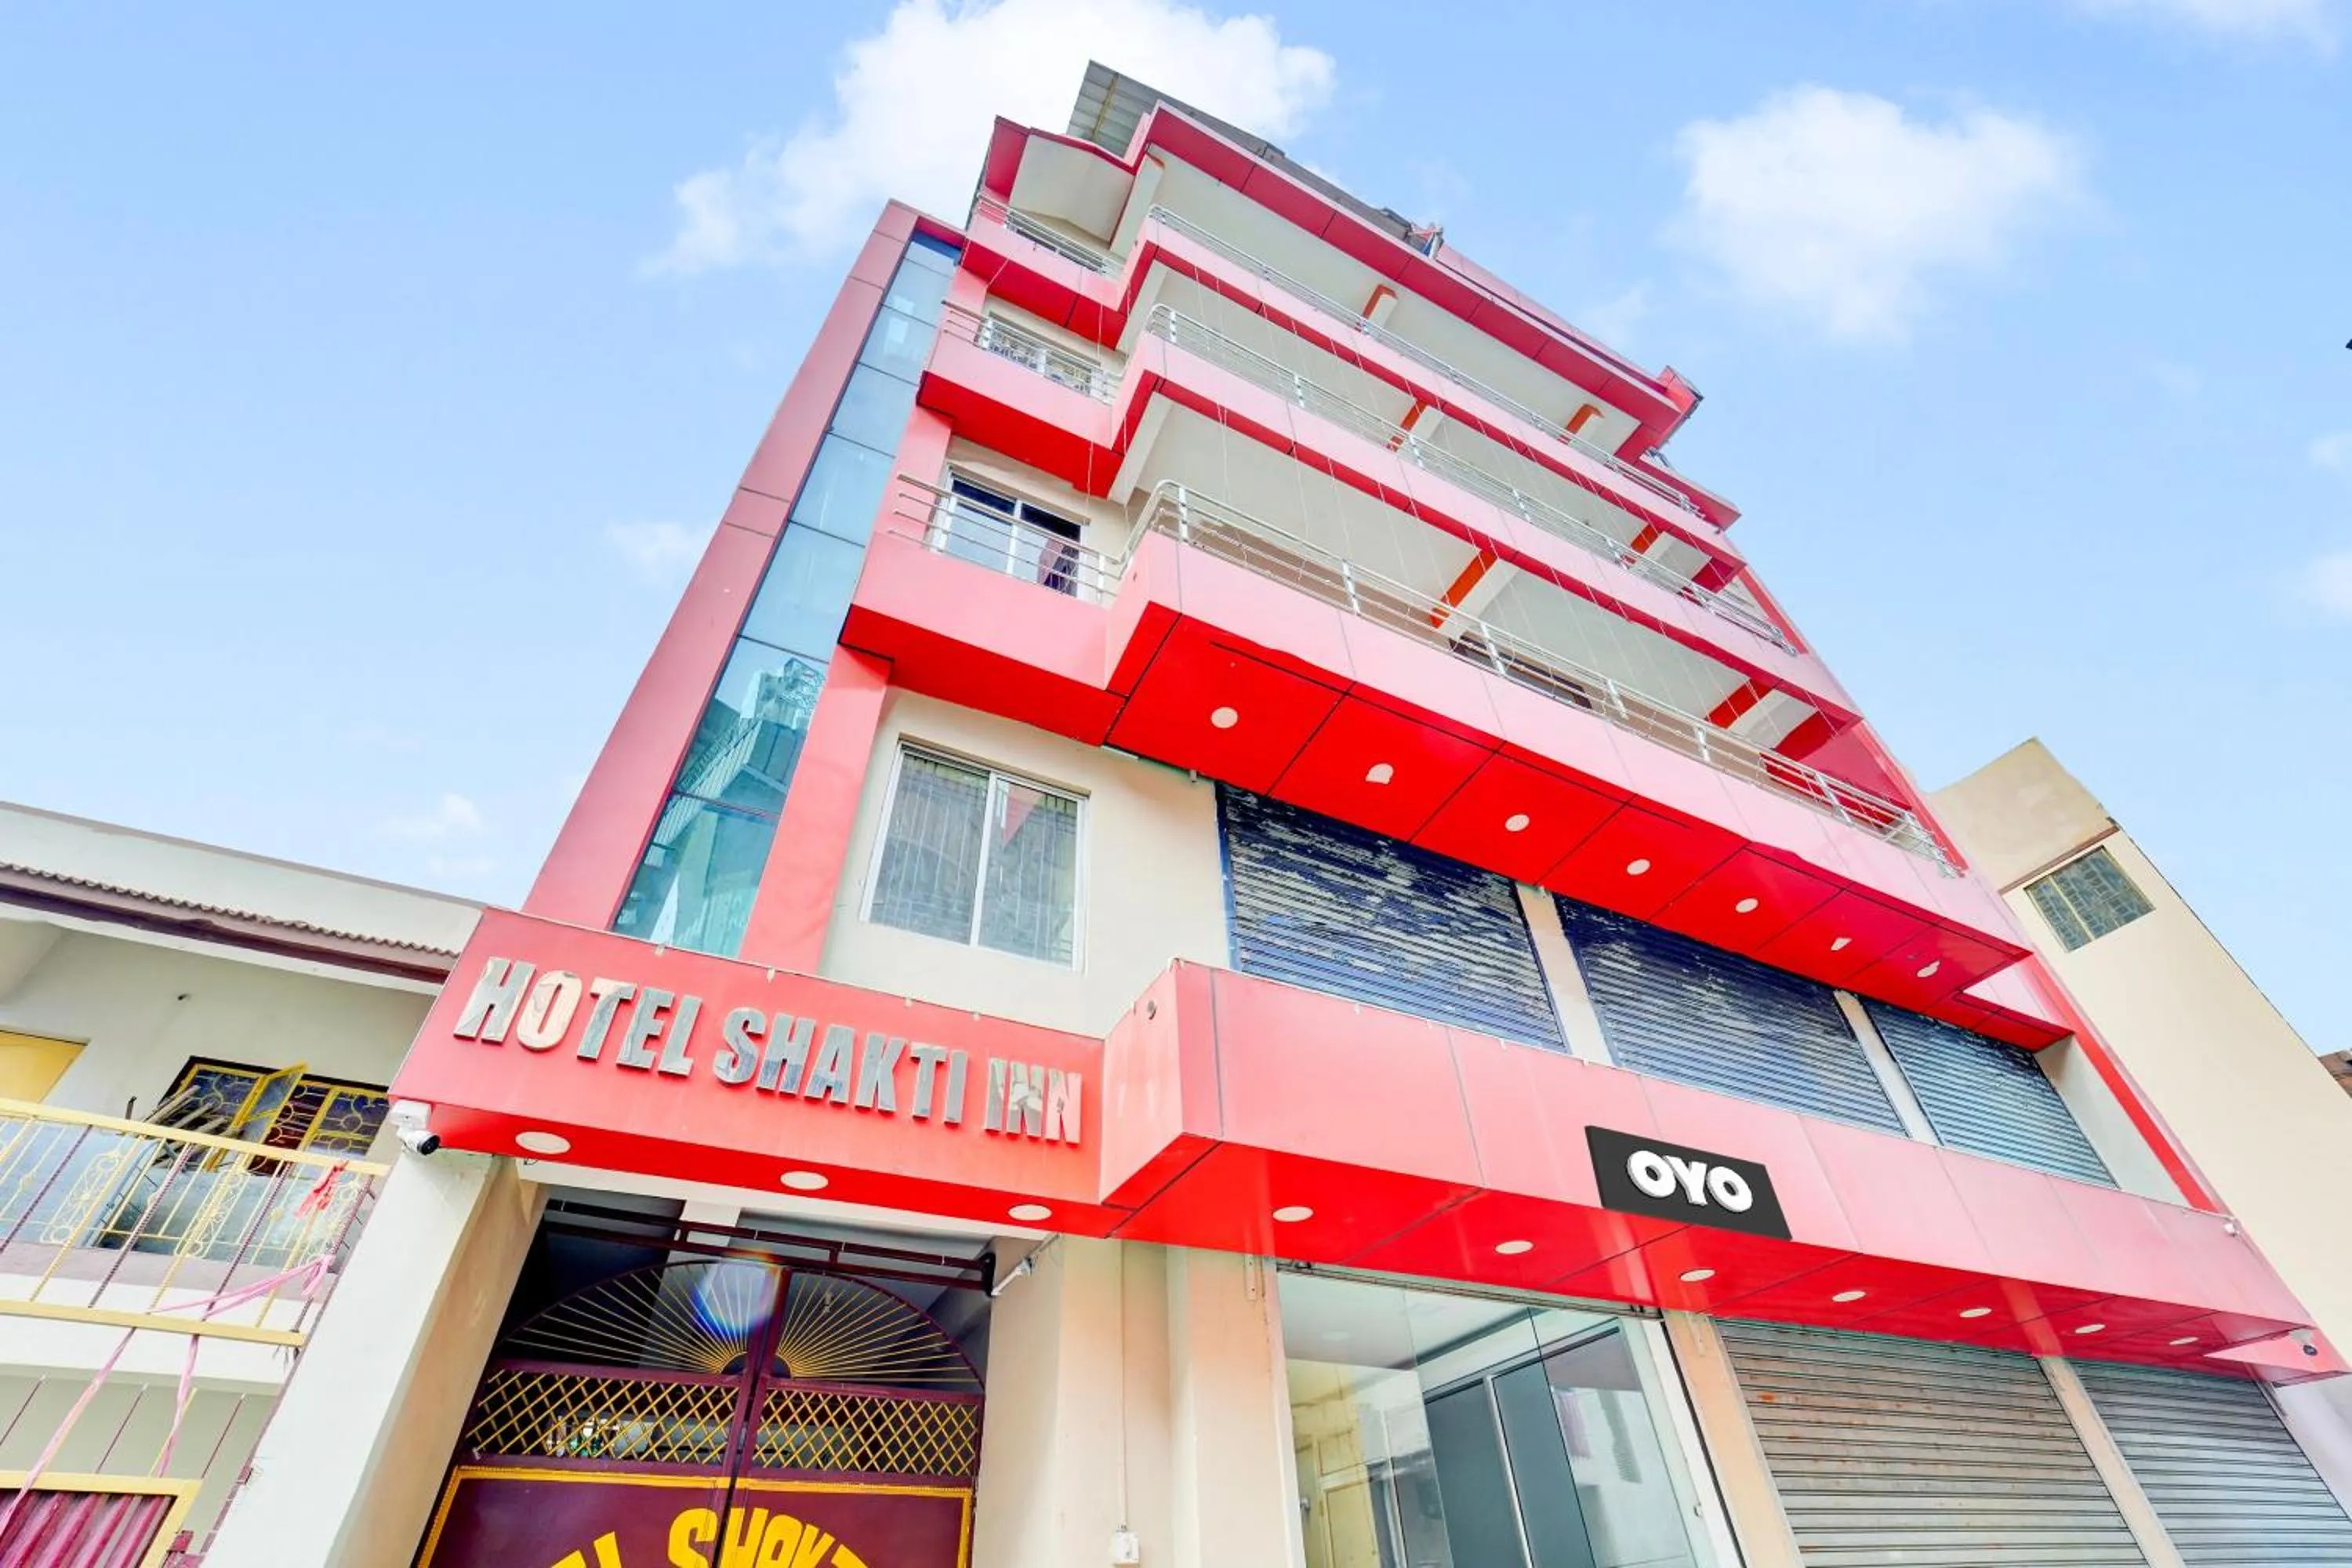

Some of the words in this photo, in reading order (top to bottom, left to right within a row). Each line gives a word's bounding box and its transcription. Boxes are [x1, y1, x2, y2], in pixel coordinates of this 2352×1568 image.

[453, 956, 702, 1078] HOTEL
[713, 1007, 971, 1125] SHAKTI
[984, 1057, 1083, 1145] INN
[1626, 1149, 1754, 1213] OYO
